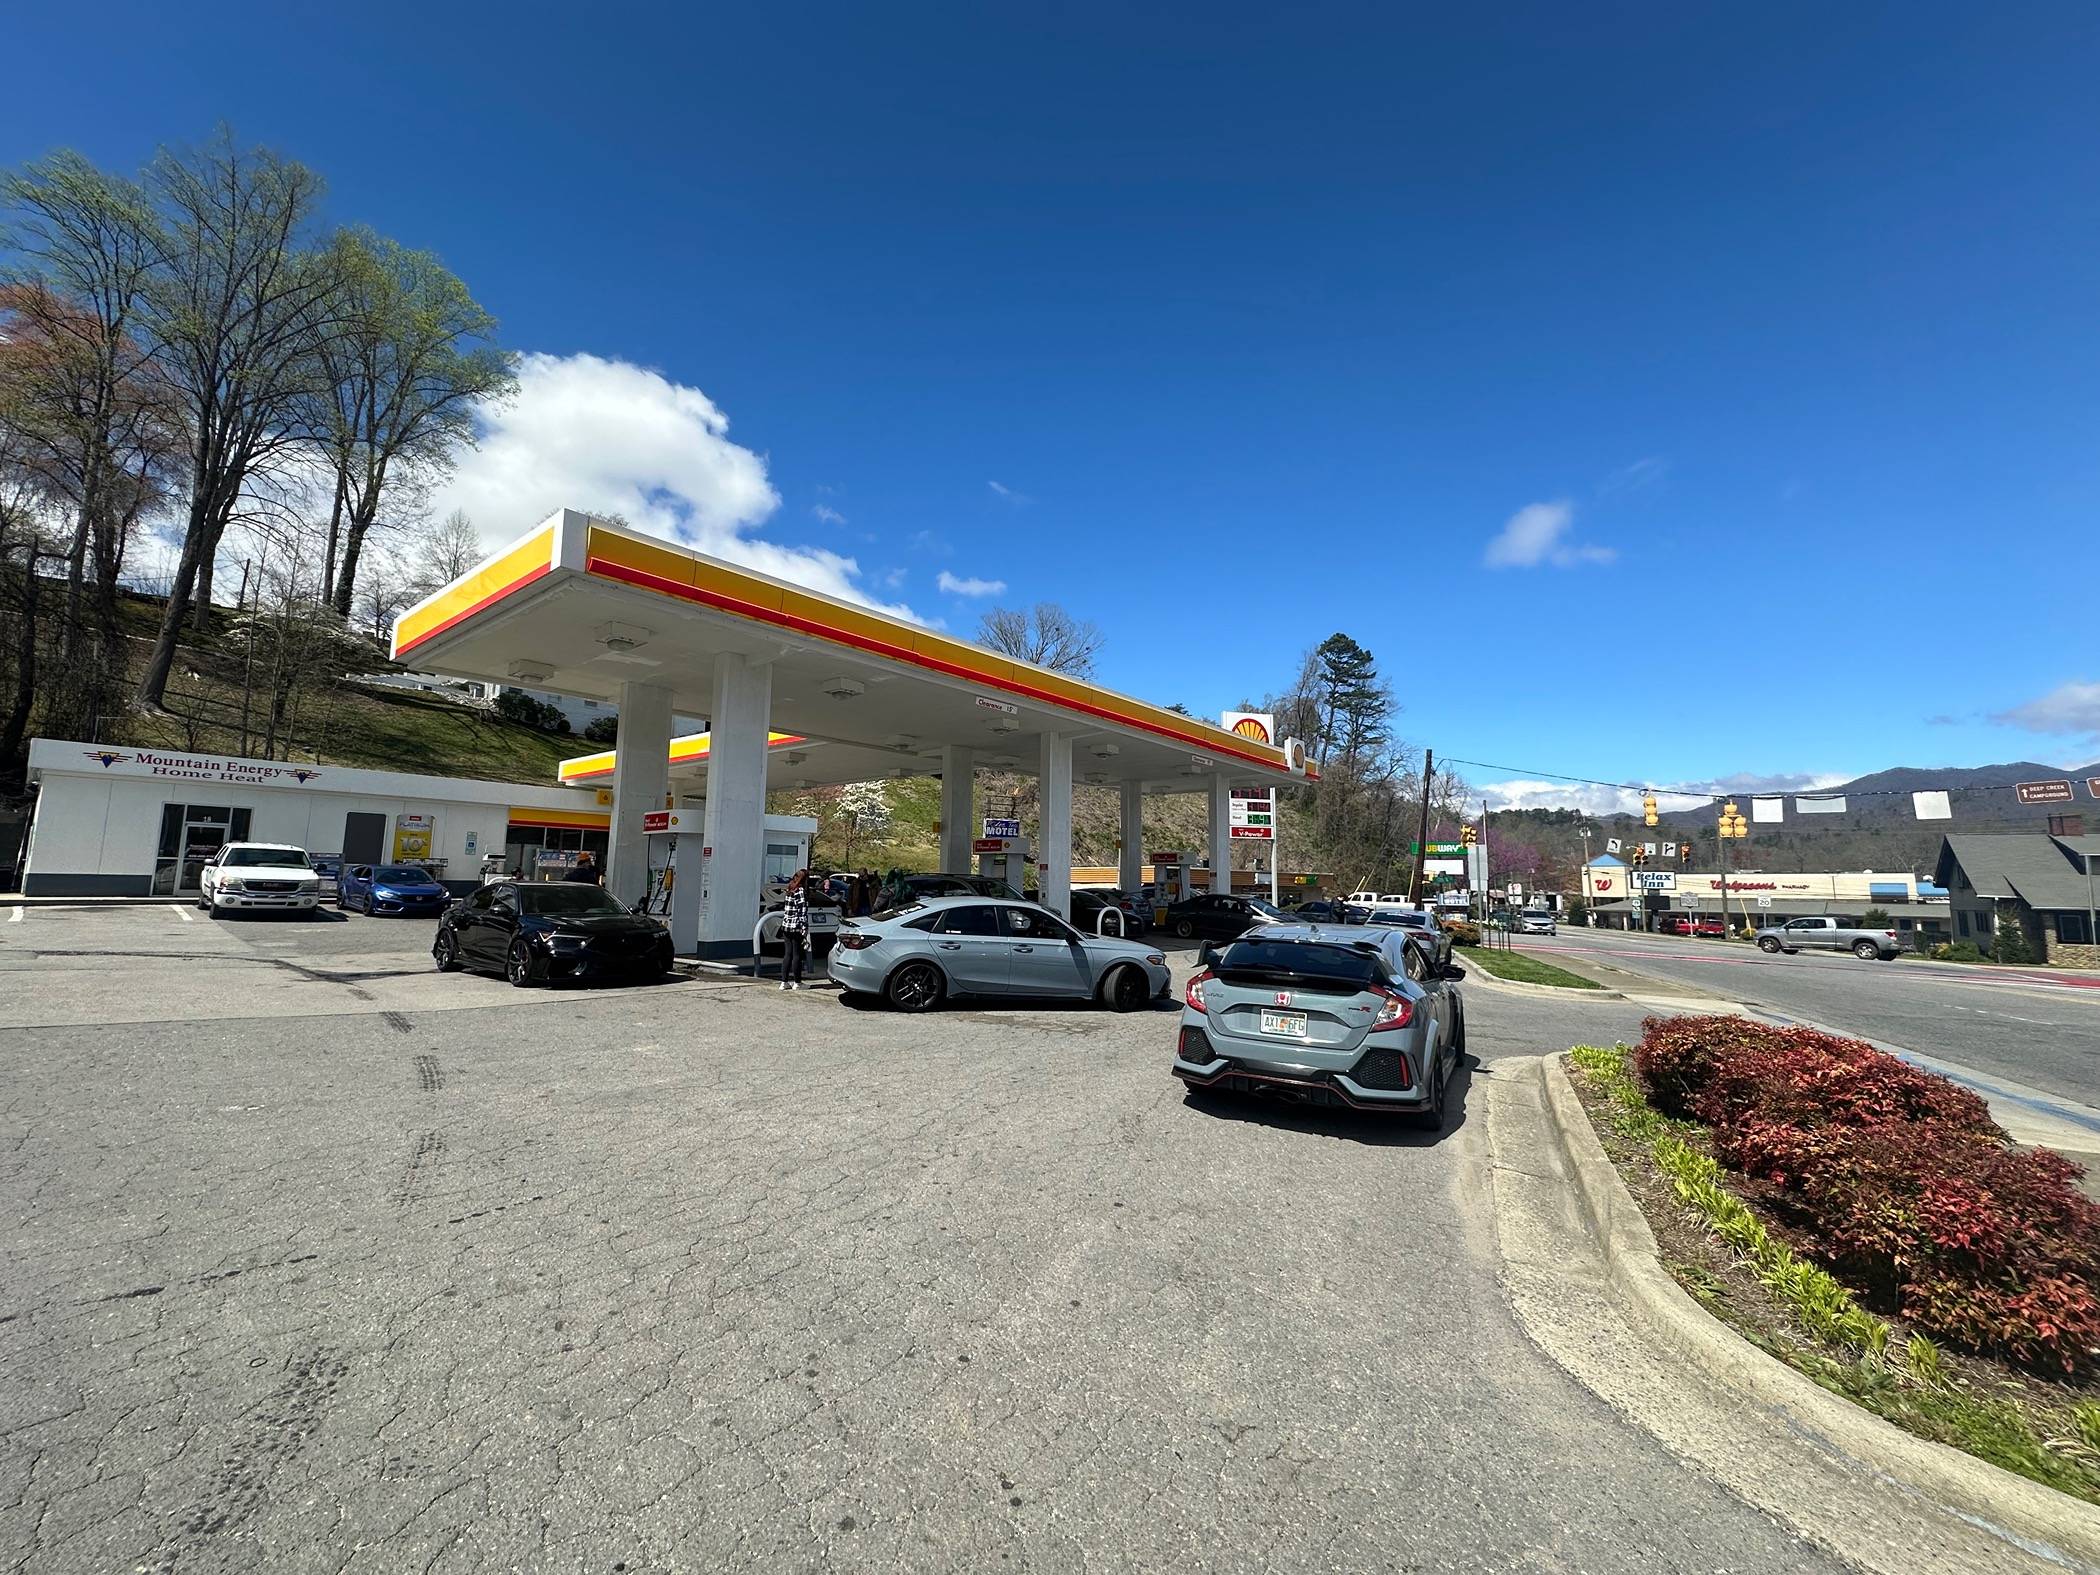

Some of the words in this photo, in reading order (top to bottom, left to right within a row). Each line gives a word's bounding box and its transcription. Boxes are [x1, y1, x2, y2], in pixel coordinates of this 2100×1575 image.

[978, 699, 1002, 710] Clearance
[136, 753, 220, 771] Mountain
[227, 761, 282, 777] Energy
[152, 767, 212, 779] Home
[220, 772, 264, 784] Heat
[986, 827, 1018, 836] MOTEL
[1426, 844, 1461, 853] UBWAY
[1636, 873, 1671, 881] Relax
